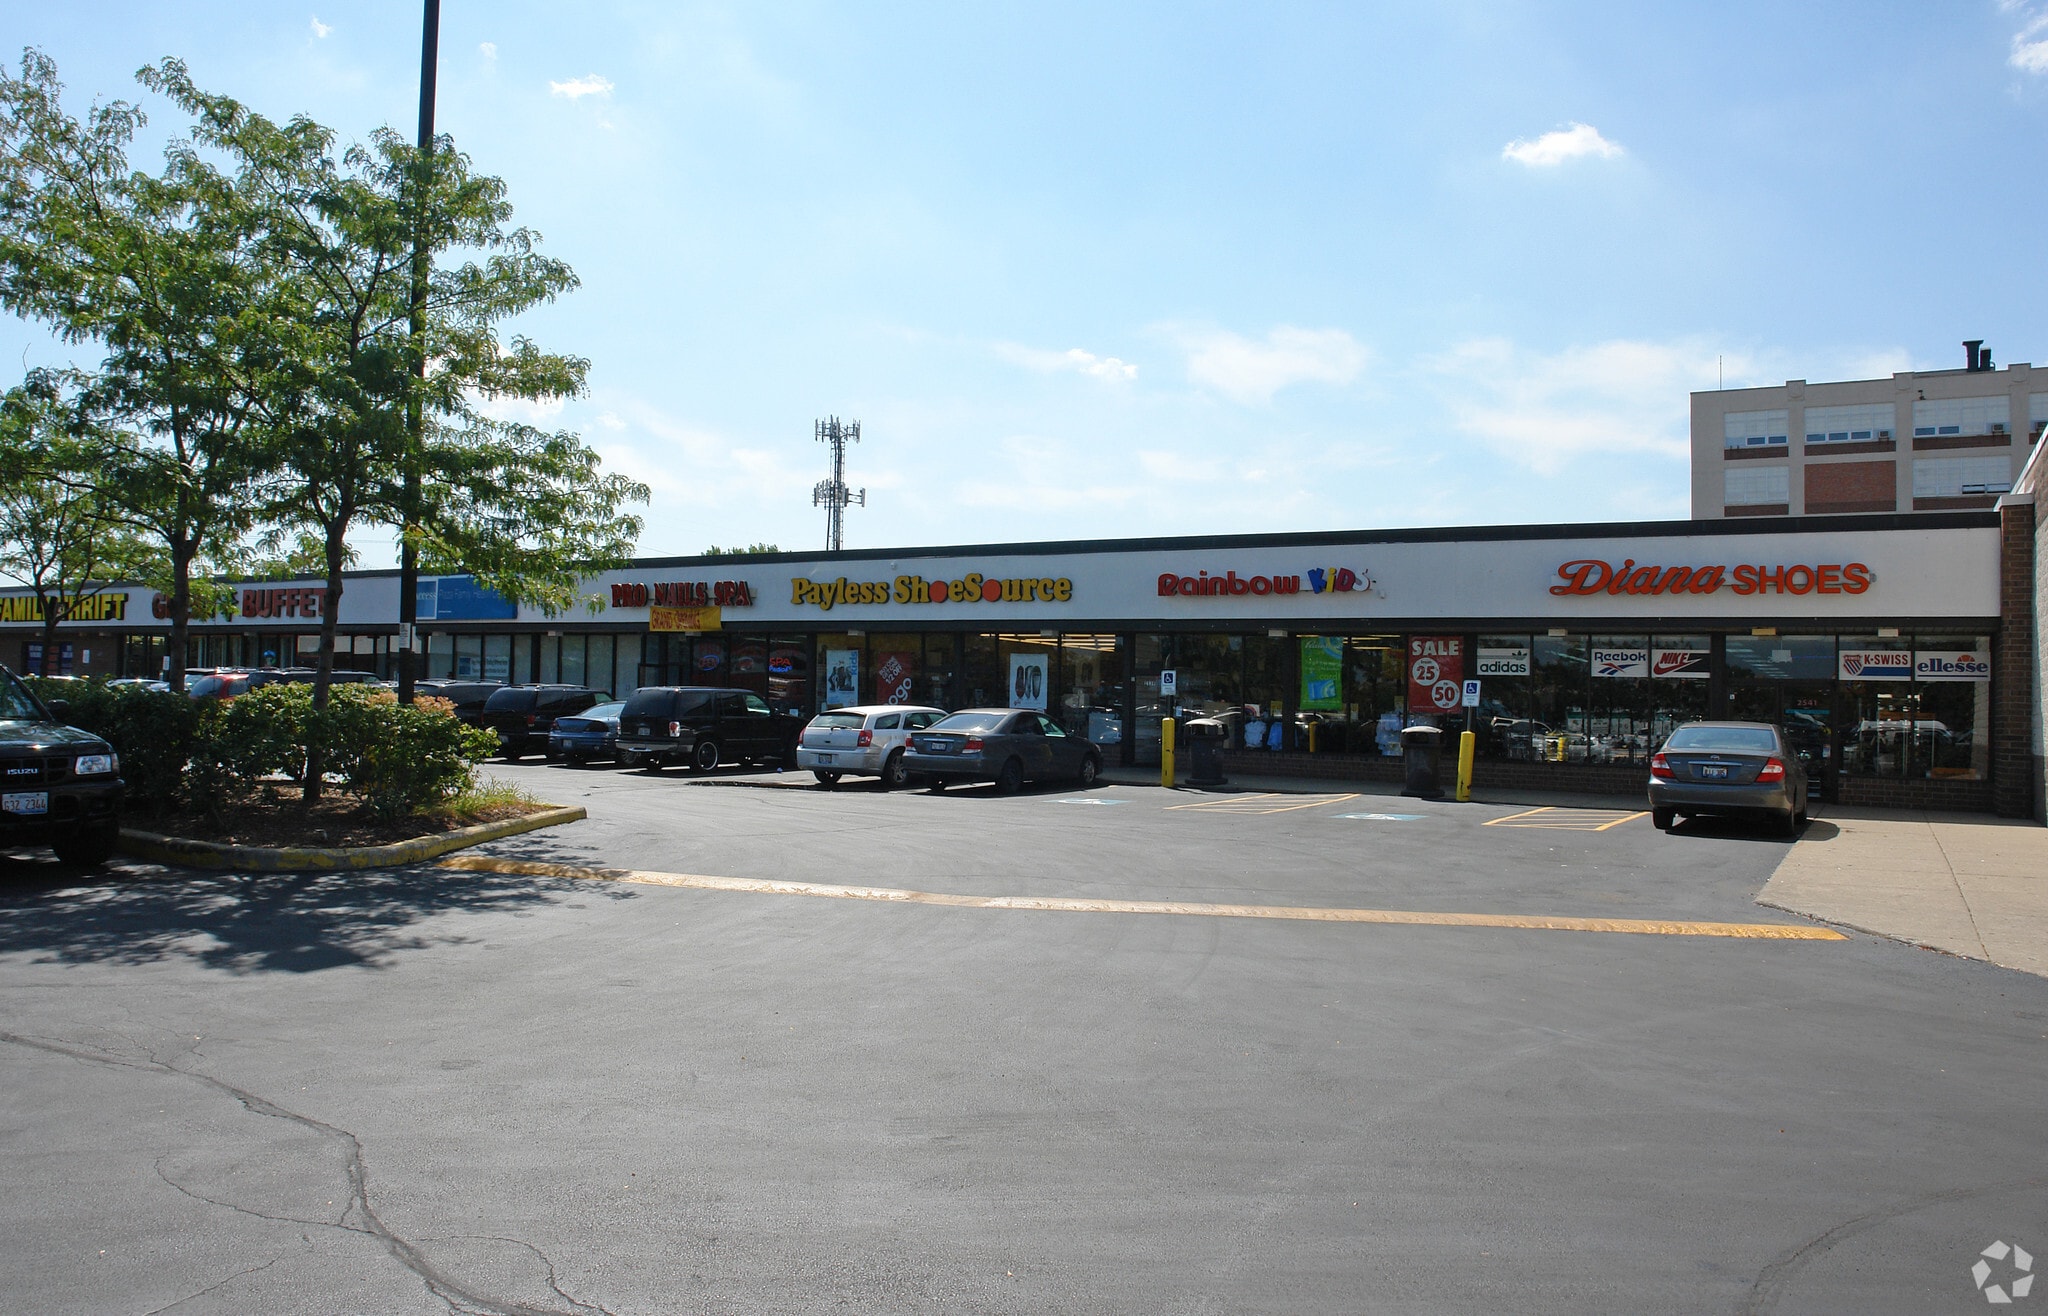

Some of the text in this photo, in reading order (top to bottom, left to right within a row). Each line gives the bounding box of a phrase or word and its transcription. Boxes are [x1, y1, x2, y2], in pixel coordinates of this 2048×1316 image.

[1157, 570, 1300, 597] Rainbow
[1550, 558, 1871, 596] Diana SHOES
[611, 580, 751, 607] PRO NAILS SPA
[791, 573, 1071, 610] Payless ShoeSource
[1412, 640, 1459, 656] SALE
[769, 657, 791, 666] SPA
[1594, 652, 1646, 662] Reebok
[1660, 653, 1688, 664] NIKE
[1416, 665, 1435, 680] 25
[1480, 661, 1526, 673] adidas
[1917, 658, 1988, 673] ellesse
[884, 677, 912, 704] ogo
[1435, 686, 1455, 702] 50
